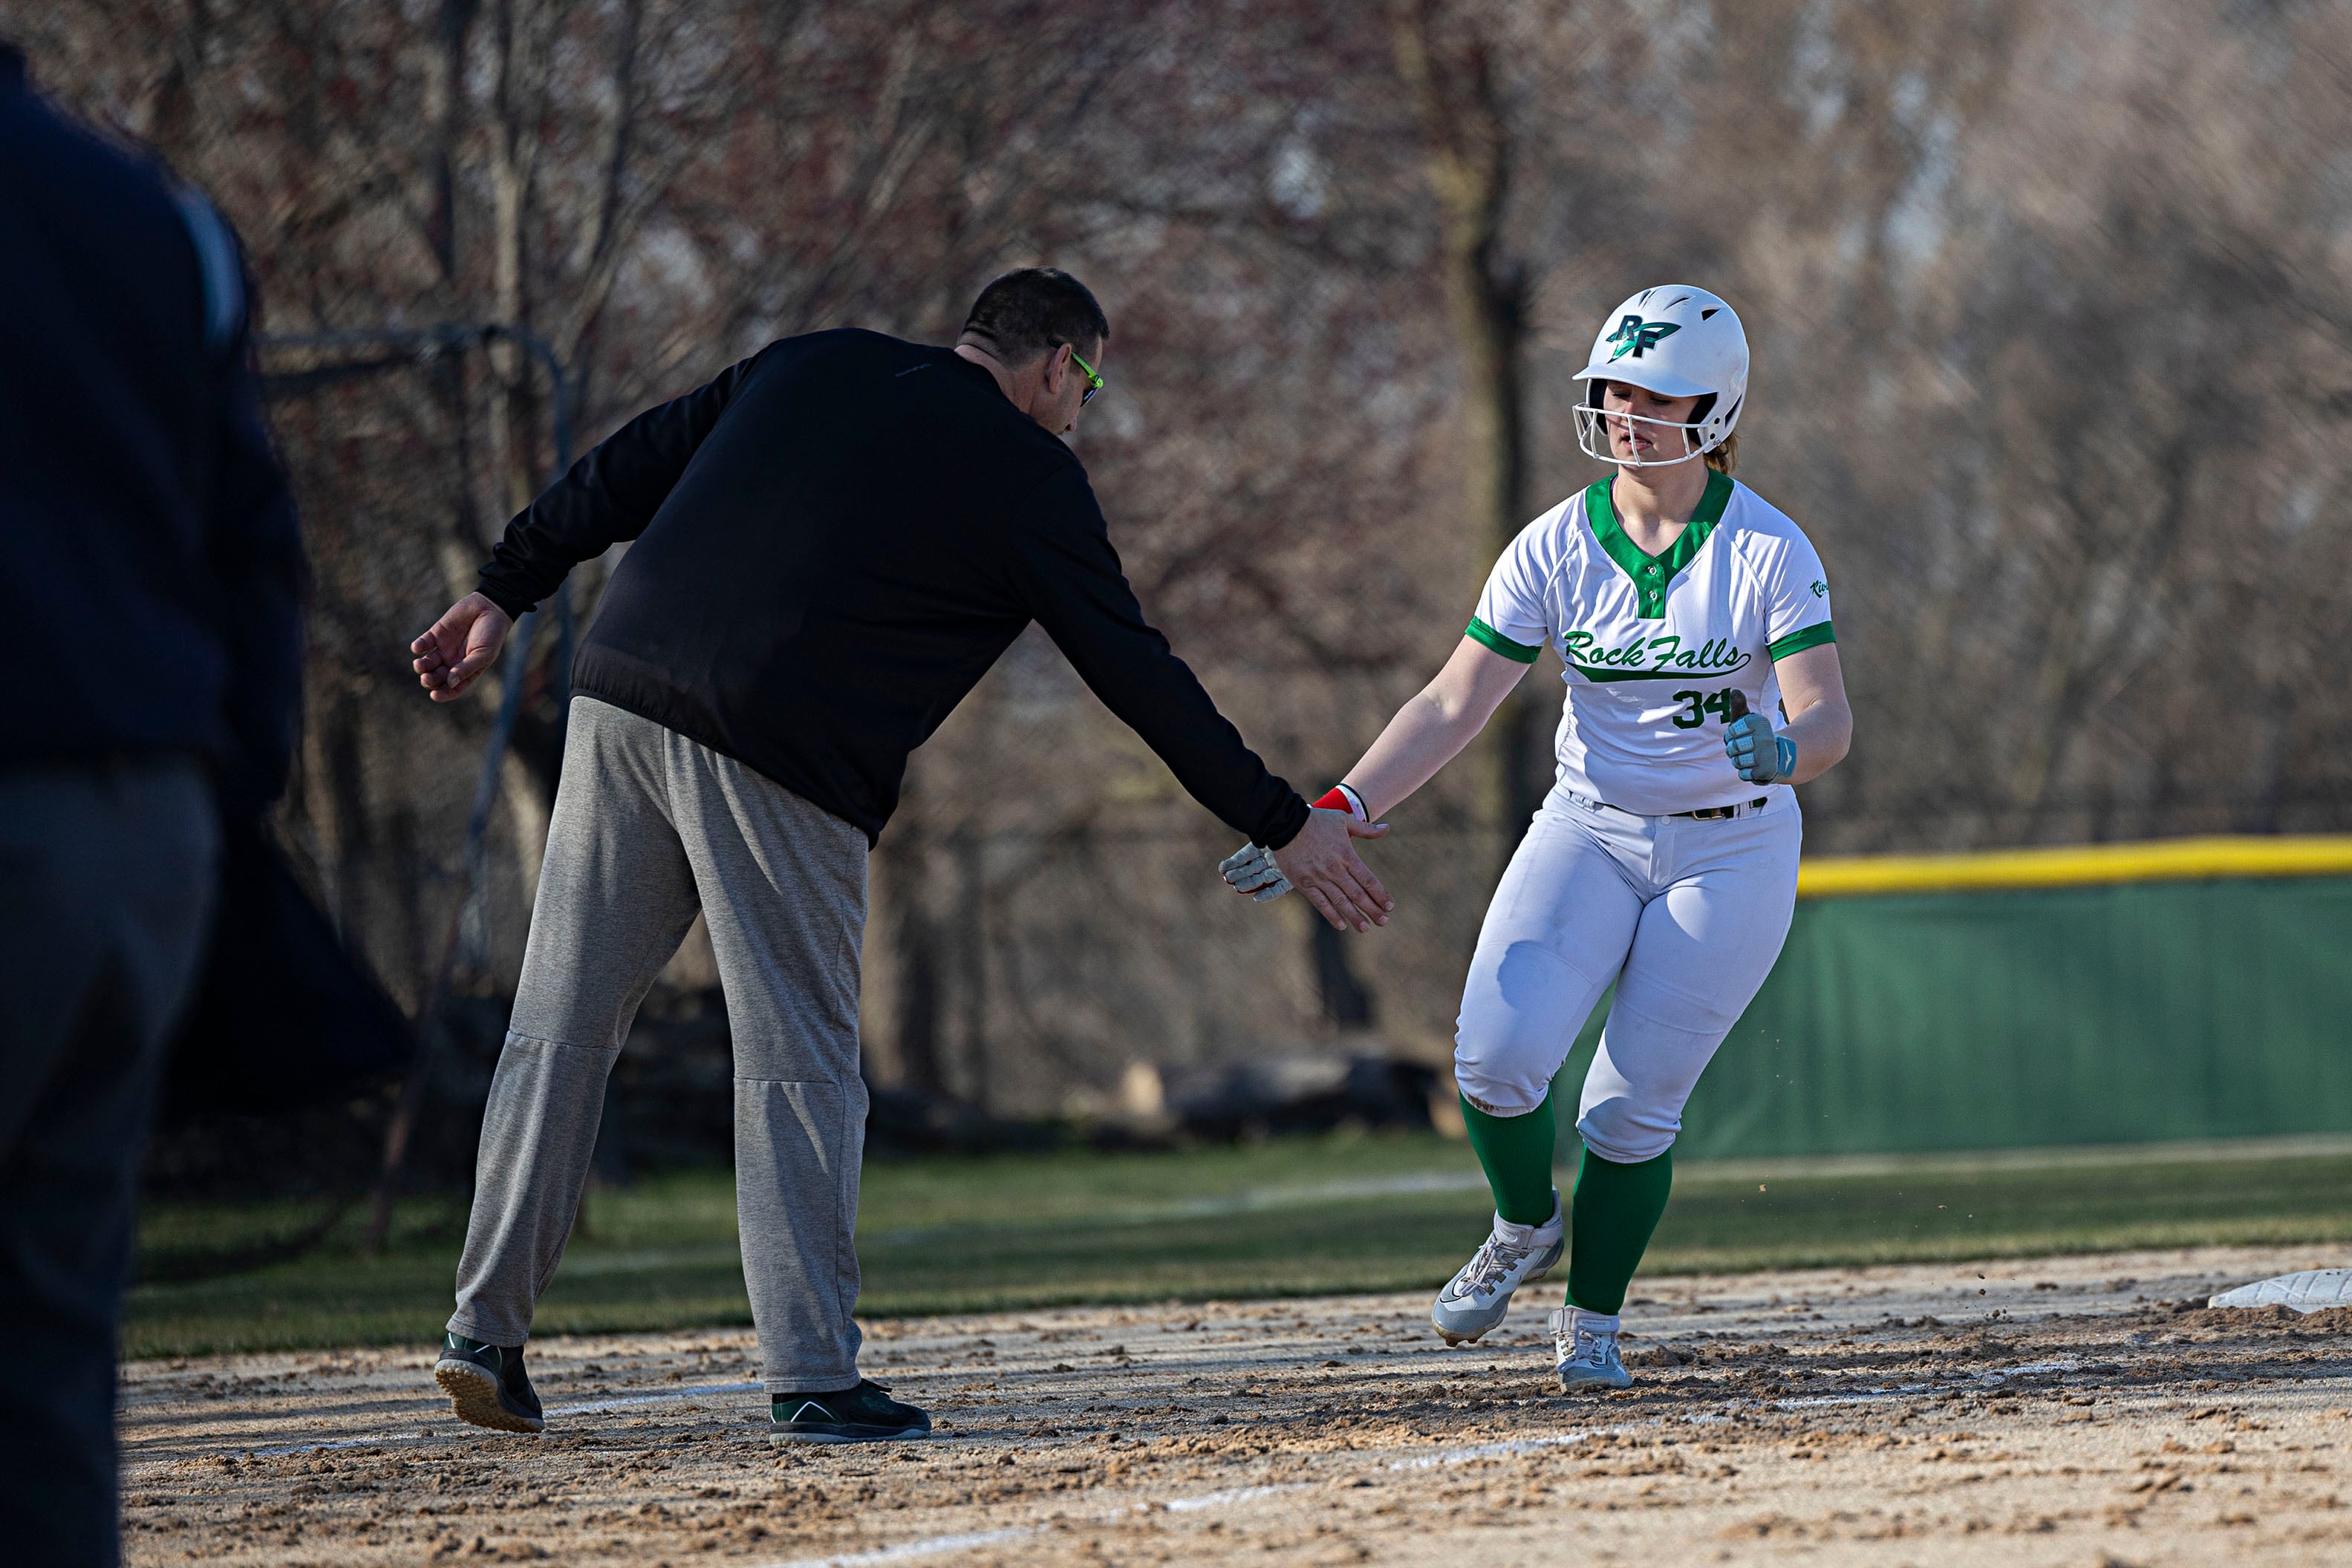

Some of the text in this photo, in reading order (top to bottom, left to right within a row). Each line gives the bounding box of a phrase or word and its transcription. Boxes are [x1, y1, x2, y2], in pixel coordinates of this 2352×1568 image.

[1616, 315, 1660, 359] RF
[1564, 631, 1751, 671] Rock Falls
[1672, 687, 1731, 729] 34
